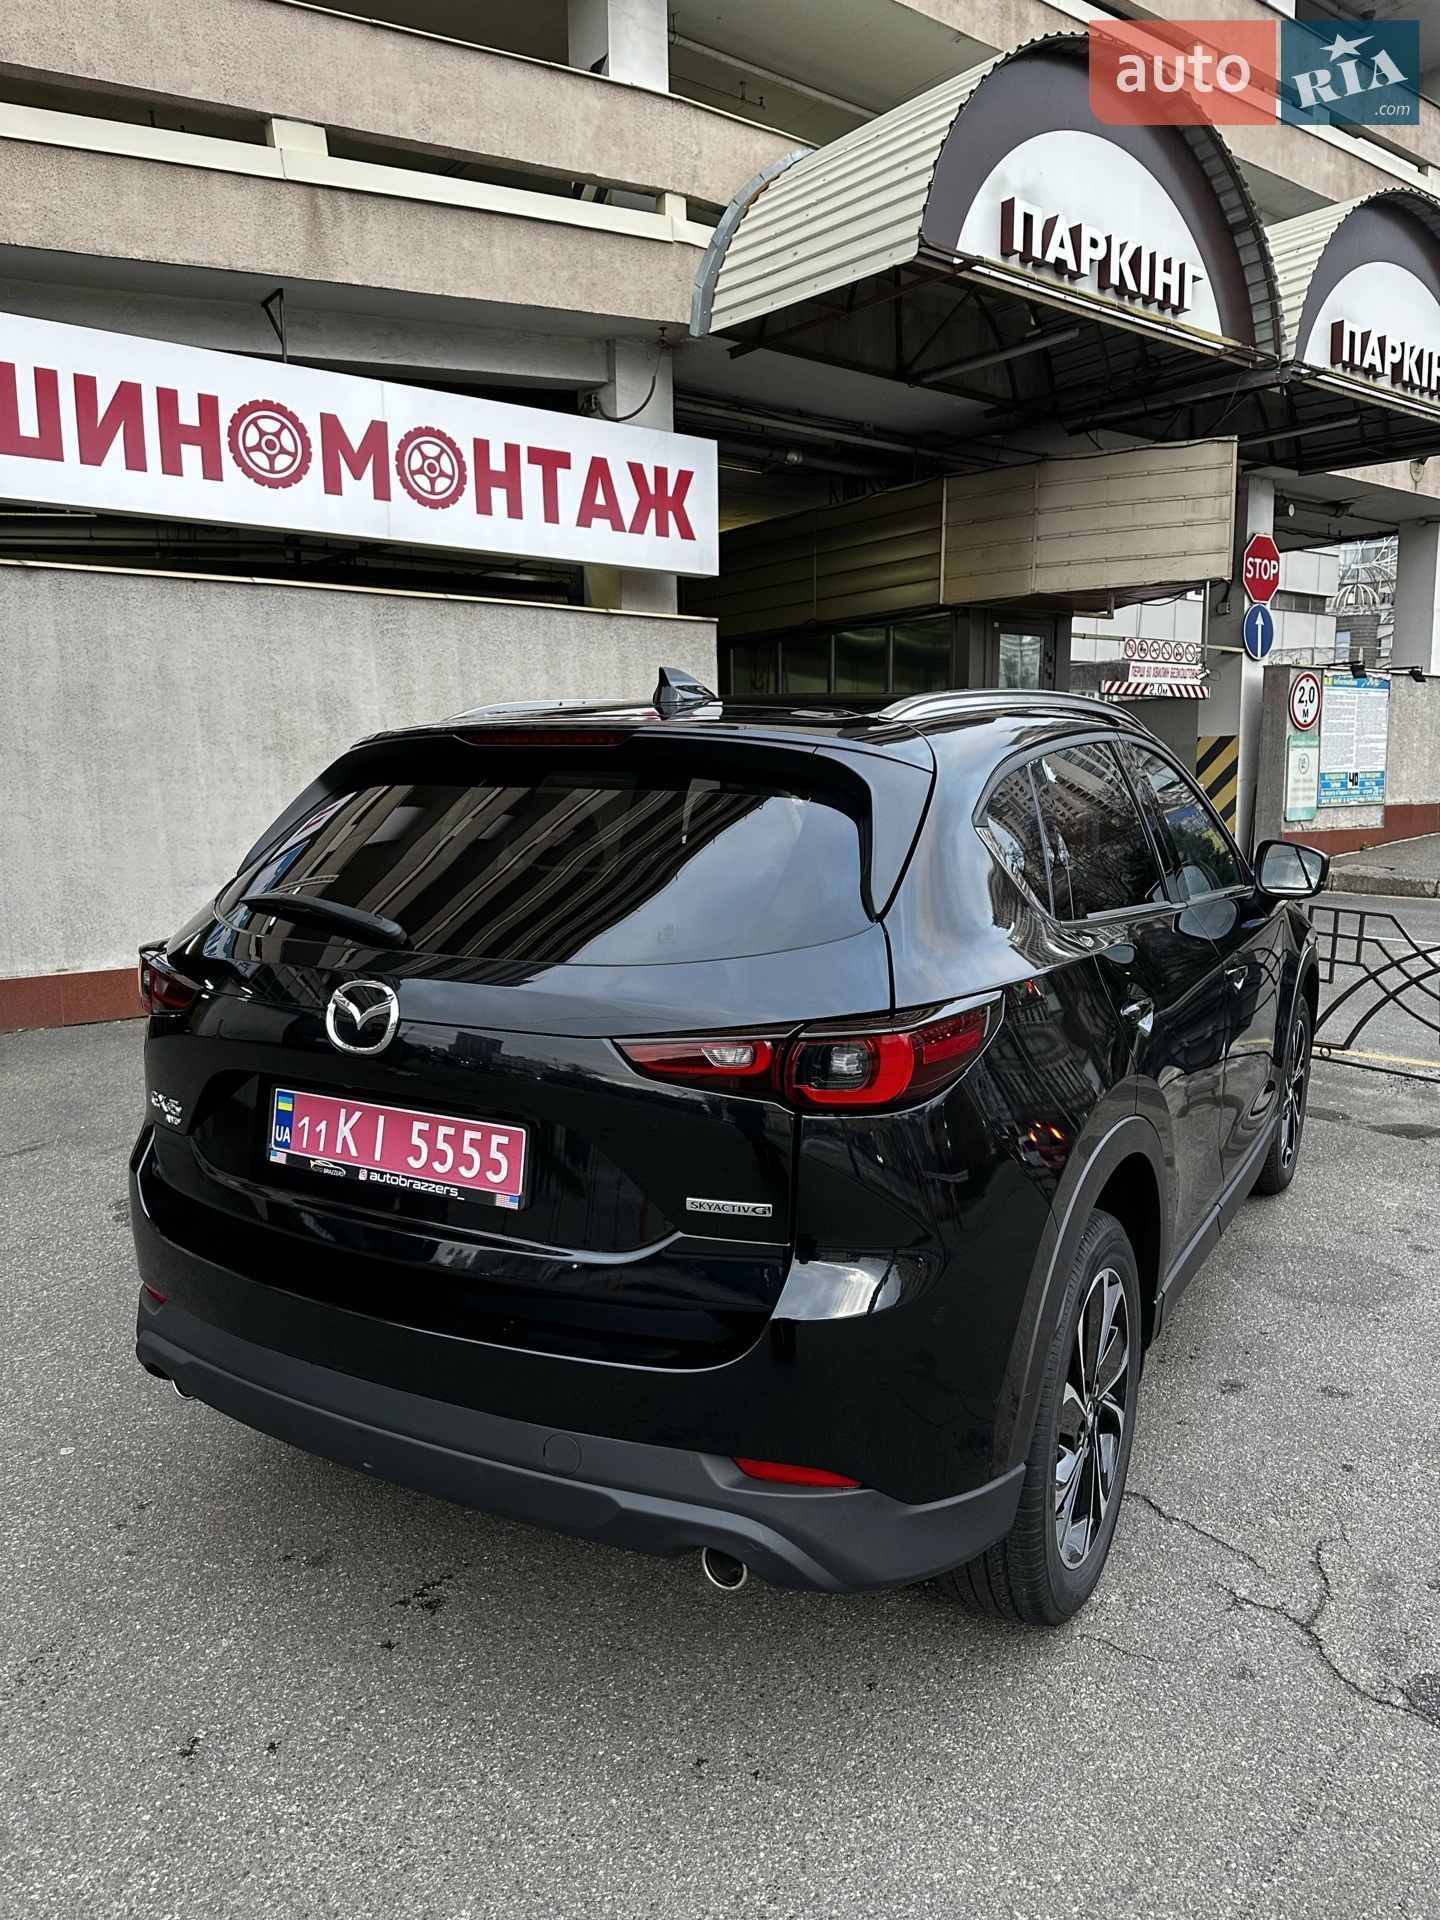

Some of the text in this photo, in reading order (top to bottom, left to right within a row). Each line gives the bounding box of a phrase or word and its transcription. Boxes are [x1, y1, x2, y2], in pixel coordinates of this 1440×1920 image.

[1002, 197, 1204, 313] ПАРКІНГ
[1246, 557, 1279, 580] STOP
[1298, 686, 1315, 707] 2,0
[275, 1125, 291, 1144] UA
[407, 1120, 509, 1184] 5555
